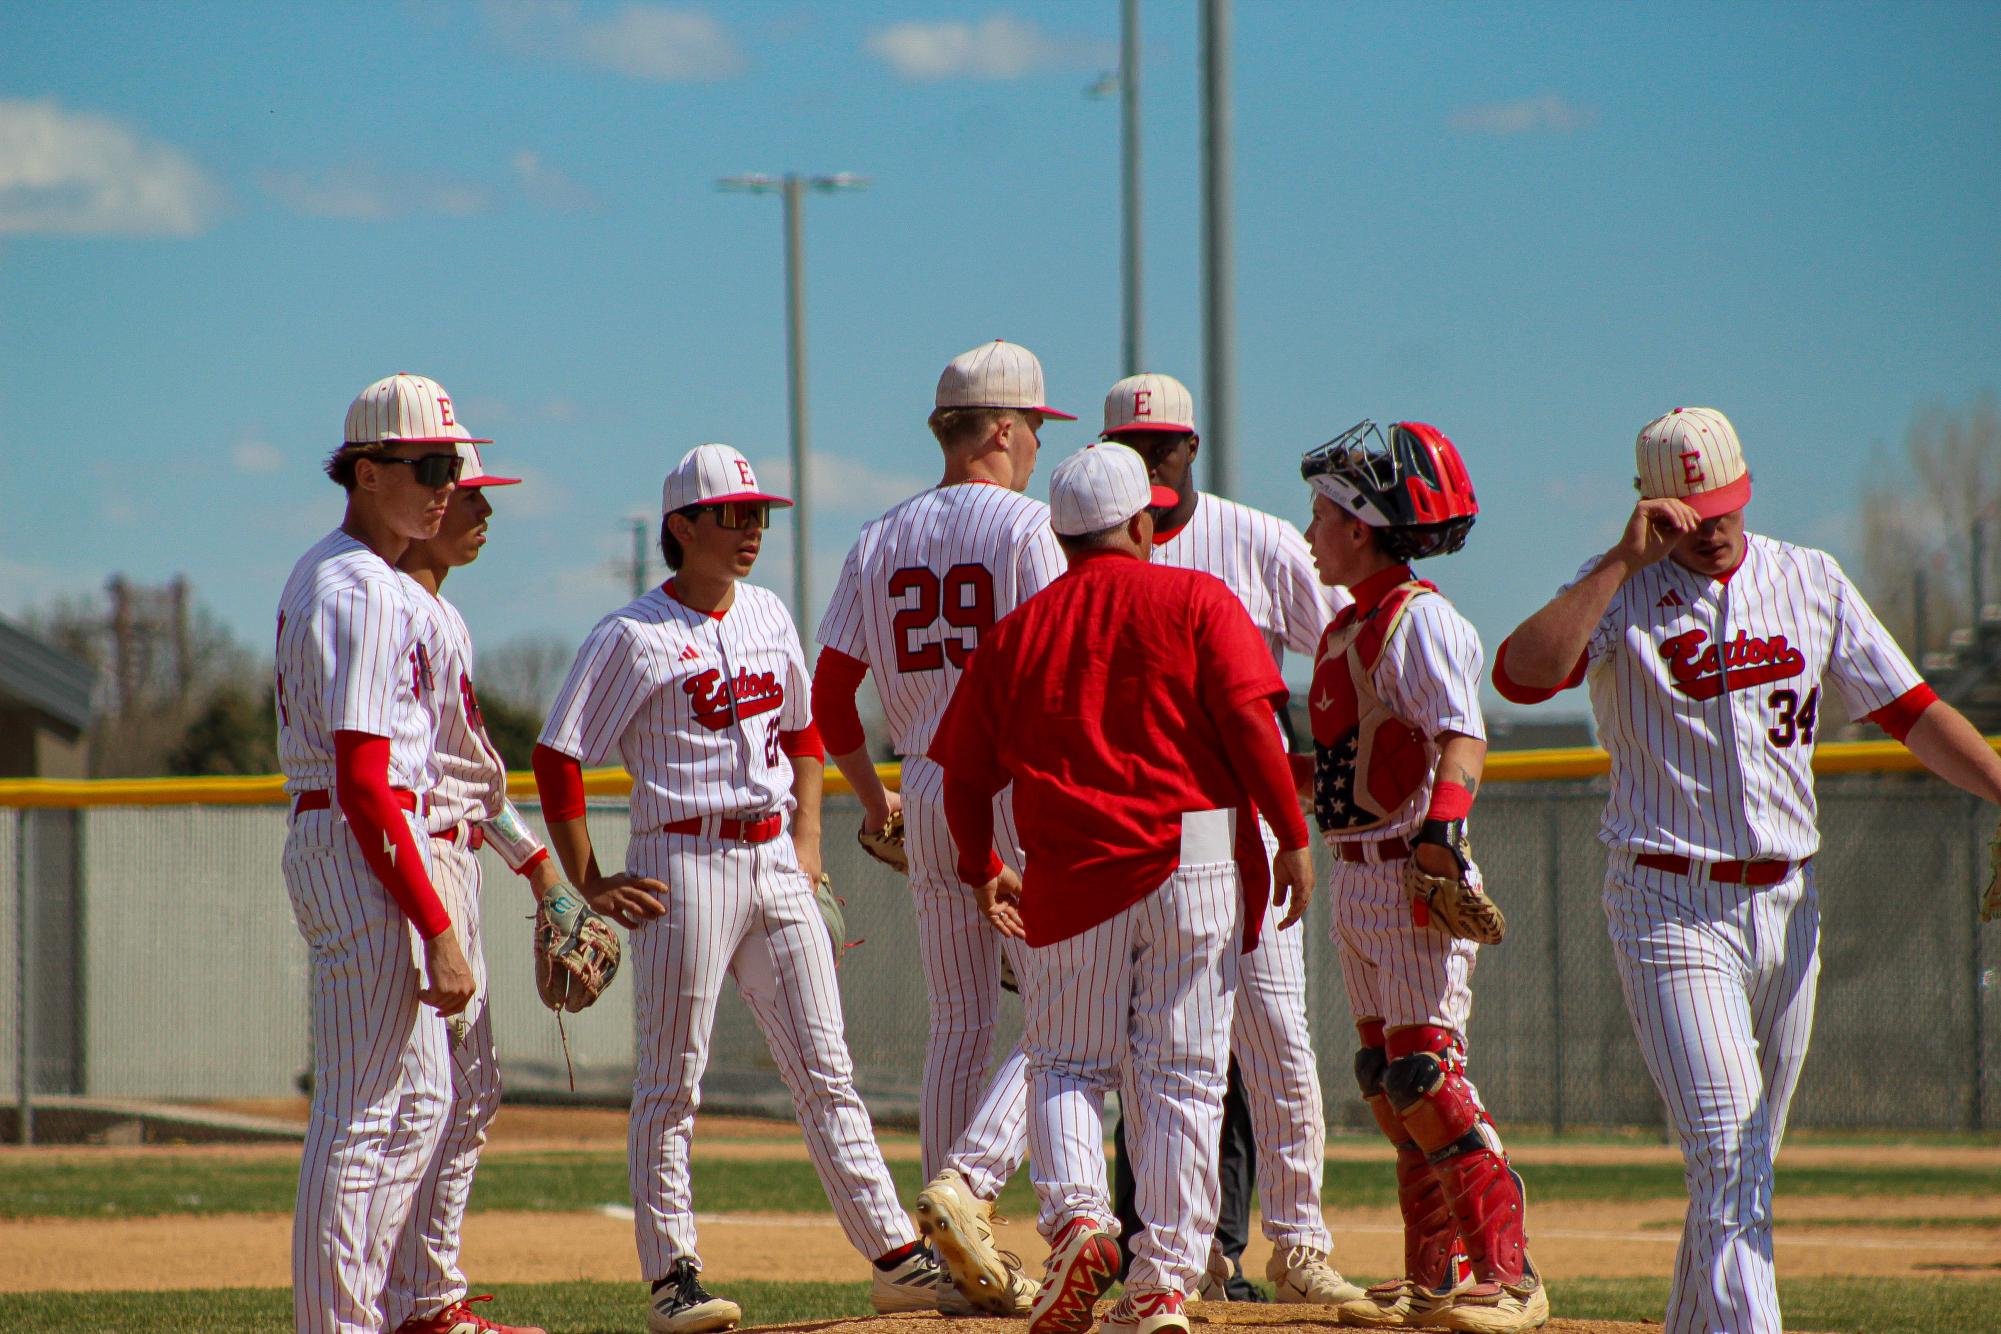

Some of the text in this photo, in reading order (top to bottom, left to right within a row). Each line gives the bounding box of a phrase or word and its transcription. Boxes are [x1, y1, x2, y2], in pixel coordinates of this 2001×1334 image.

[437, 398, 453, 426] E
[1133, 391, 1152, 416] E
[734, 460, 754, 486] E
[1680, 450, 1705, 484] E
[888, 562, 995, 673] 29
[1659, 628, 1800, 684] Eaton
[682, 666, 782, 716] Eaton
[1768, 683, 1819, 748] 34
